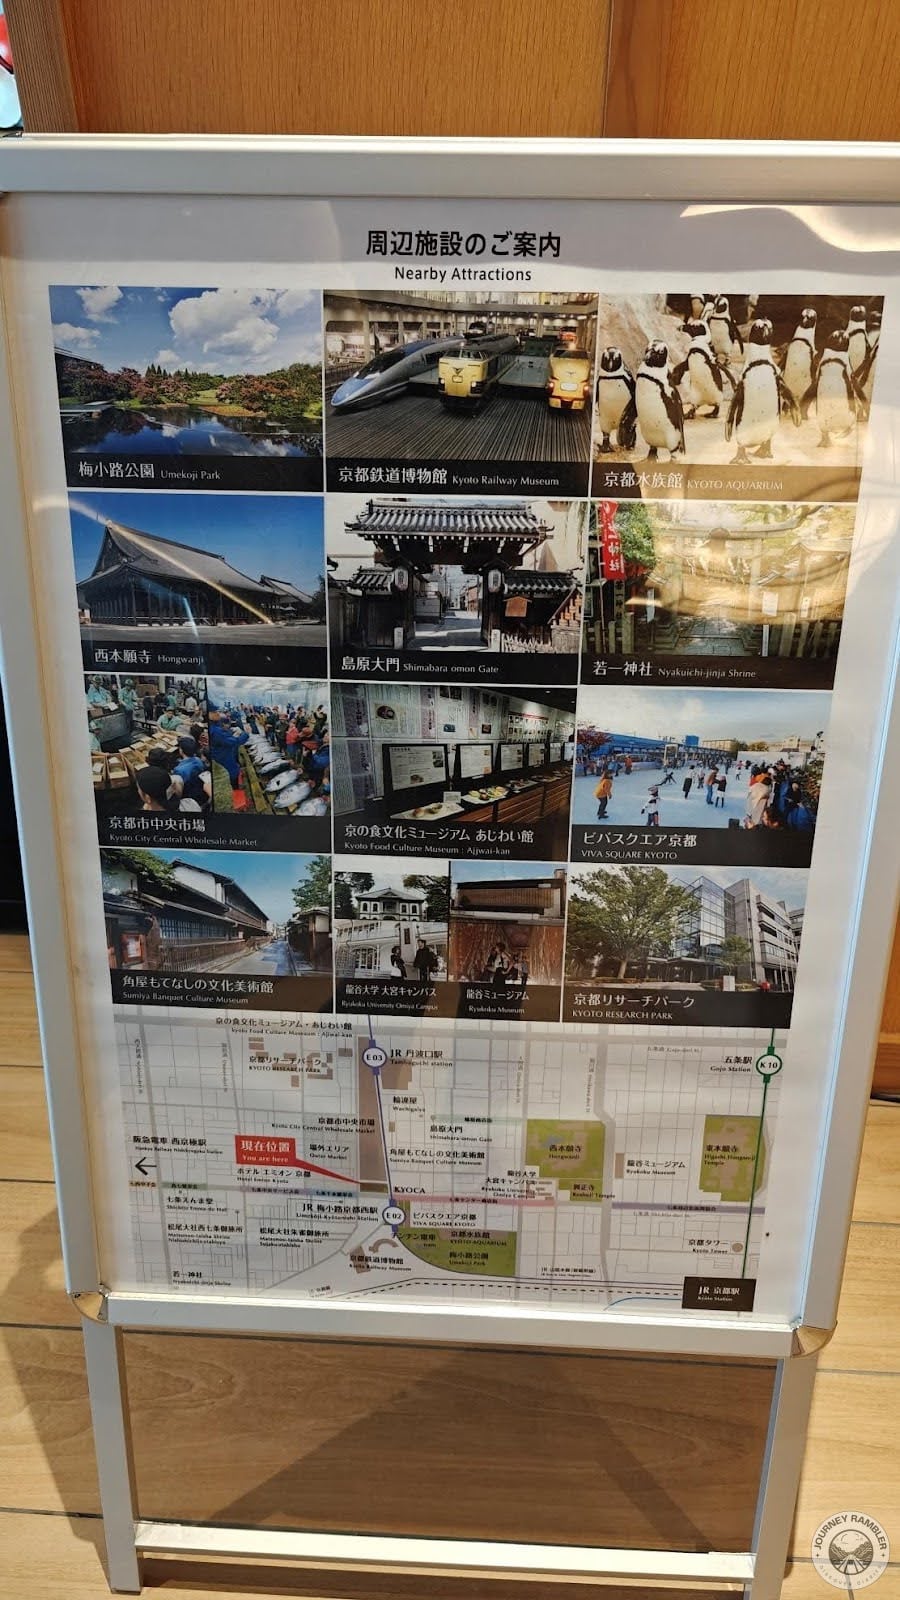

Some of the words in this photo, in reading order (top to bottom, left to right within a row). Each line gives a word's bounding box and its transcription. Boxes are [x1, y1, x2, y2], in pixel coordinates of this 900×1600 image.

[367, 231, 561, 257] 周辺施設のご案内
[395, 267, 446, 283] Nearby
[452, 268, 532, 281] Attractions
[79, 462, 154, 479] 梅小路公園
[161, 470, 199, 481] Umekoji
[201, 471, 221, 480] Park
[338, 467, 448, 485] 京都鉄道博物館
[453, 475, 479, 486] Kyoto
[482, 476, 517, 487] Railway
[521, 477, 559, 486] Museum
[604, 471, 683, 489] 京都水族館
[688, 480, 724, 489] KYOTO
[726, 480, 783, 490] AQUARIUM
[95, 649, 151, 664] 西本願寺
[158, 654, 204, 665] Hongwanji
[342, 657, 400, 672] 島原大門
[404, 663, 448, 673] Shimabara
[451, 665, 475, 673] omon
[479, 665, 499, 673] Gate
[593, 661, 652, 677] 若一神社
[658, 668, 726, 680] Nyakuichi-jinja
[728, 669, 756, 678] Shrine
[109, 817, 205, 832] 京都市中央市場
[110, 834, 133, 843] Kyoto
[135, 834, 151, 843] City
[153, 835, 183, 843] Central
[185, 836, 226, 845] Wholesale
[229, 838, 257, 846] Market
[344, 825, 471, 841] 京の食文化ミュージアム
[476, 829, 534, 844] あじわい館
[584, 832, 698, 847] ビバスクエア京都
[345, 842, 368, 851] Kyoto
[393, 843, 422, 852] Culture
[425, 845, 459, 854] Museum
[582, 850, 603, 858] VIVA
[606, 851, 642, 859] SQUARE
[645, 852, 677, 860] KYOTO
[122, 975, 274, 994] 角屋もてなしの文化美術館
[346, 985, 380, 996] 龍谷大学
[382, 985, 437, 997] 大宮キャンパス
[123, 992, 150, 1000] Sumiya
[152, 993, 184, 1003] Banquet
[217, 996, 249, 1004] Museum
[467, 988, 529, 1001] 龍谷ミュージアム
[574, 993, 695, 1009] 京都リサーチパーク
[367, 1002, 395, 1010] University
[396, 1002, 415, 1010] Omiya
[416, 1003, 439, 1011] Campus
[468, 1005, 496, 1014] Ryukoku
[573, 1010, 604, 1018] KYOTO
[606, 1011, 649, 1019] RESEARCH
[651, 1012, 673, 1020] PARK
[391, 1049, 402, 1058] JR
[725, 1056, 753, 1065] 五条駅
[430, 1125, 463, 1134] 島原大門
[241, 1140, 290, 1153] 現在位置
[394, 1186, 426, 1194] KYOCA
[303, 1203, 313, 1212] JR
[317, 1204, 378, 1214] 梅小路京都西駅
[699, 1286, 710, 1294] JR
[714, 1287, 740, 1295] 京都駅
